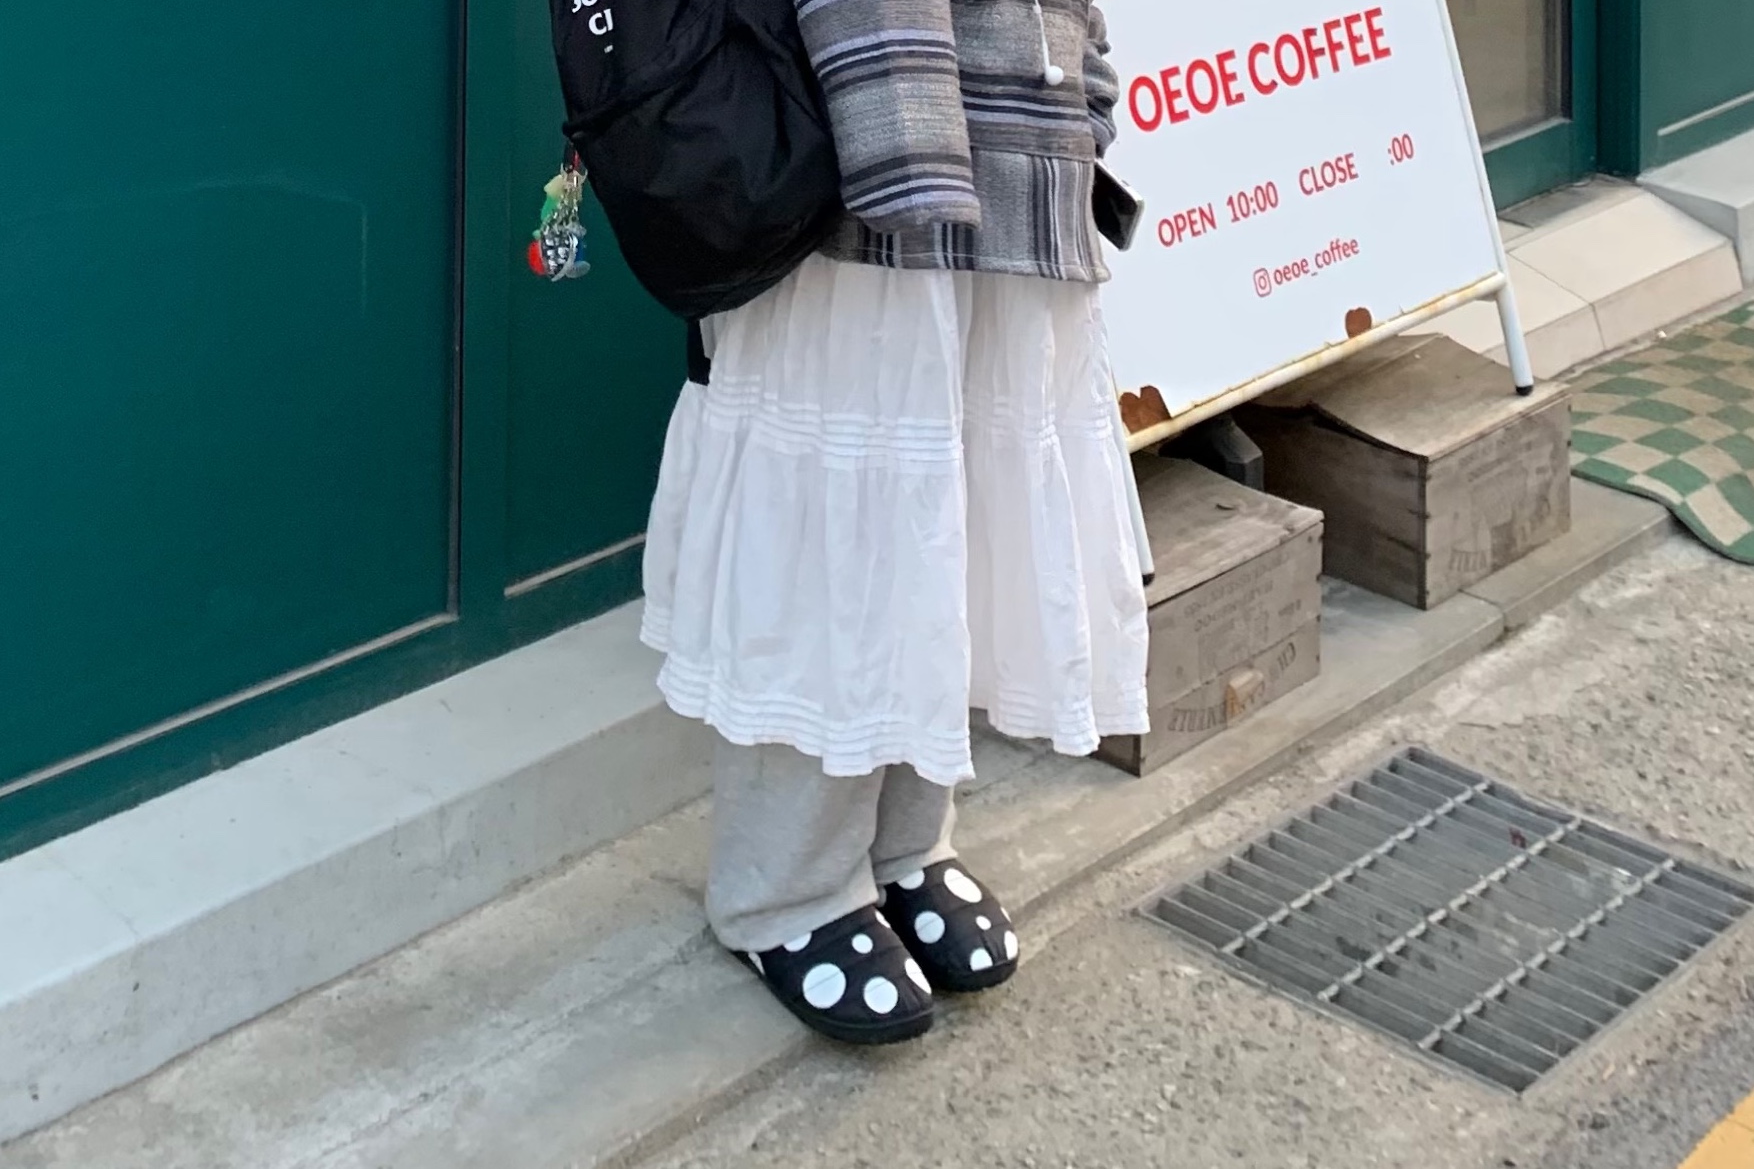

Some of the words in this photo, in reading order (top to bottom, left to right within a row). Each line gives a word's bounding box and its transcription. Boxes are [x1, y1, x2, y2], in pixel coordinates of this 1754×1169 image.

[1128, 50, 1245, 132] OEOE
[1247, 7, 1392, 95] COFFEE
[1157, 203, 1217, 247] OPEN
[1226, 181, 1279, 223] 10:00
[1299, 152, 1359, 195] CLOSE
[1387, 133, 1414, 165] :00
[1273, 237, 1360, 286] oeoe_coffee
